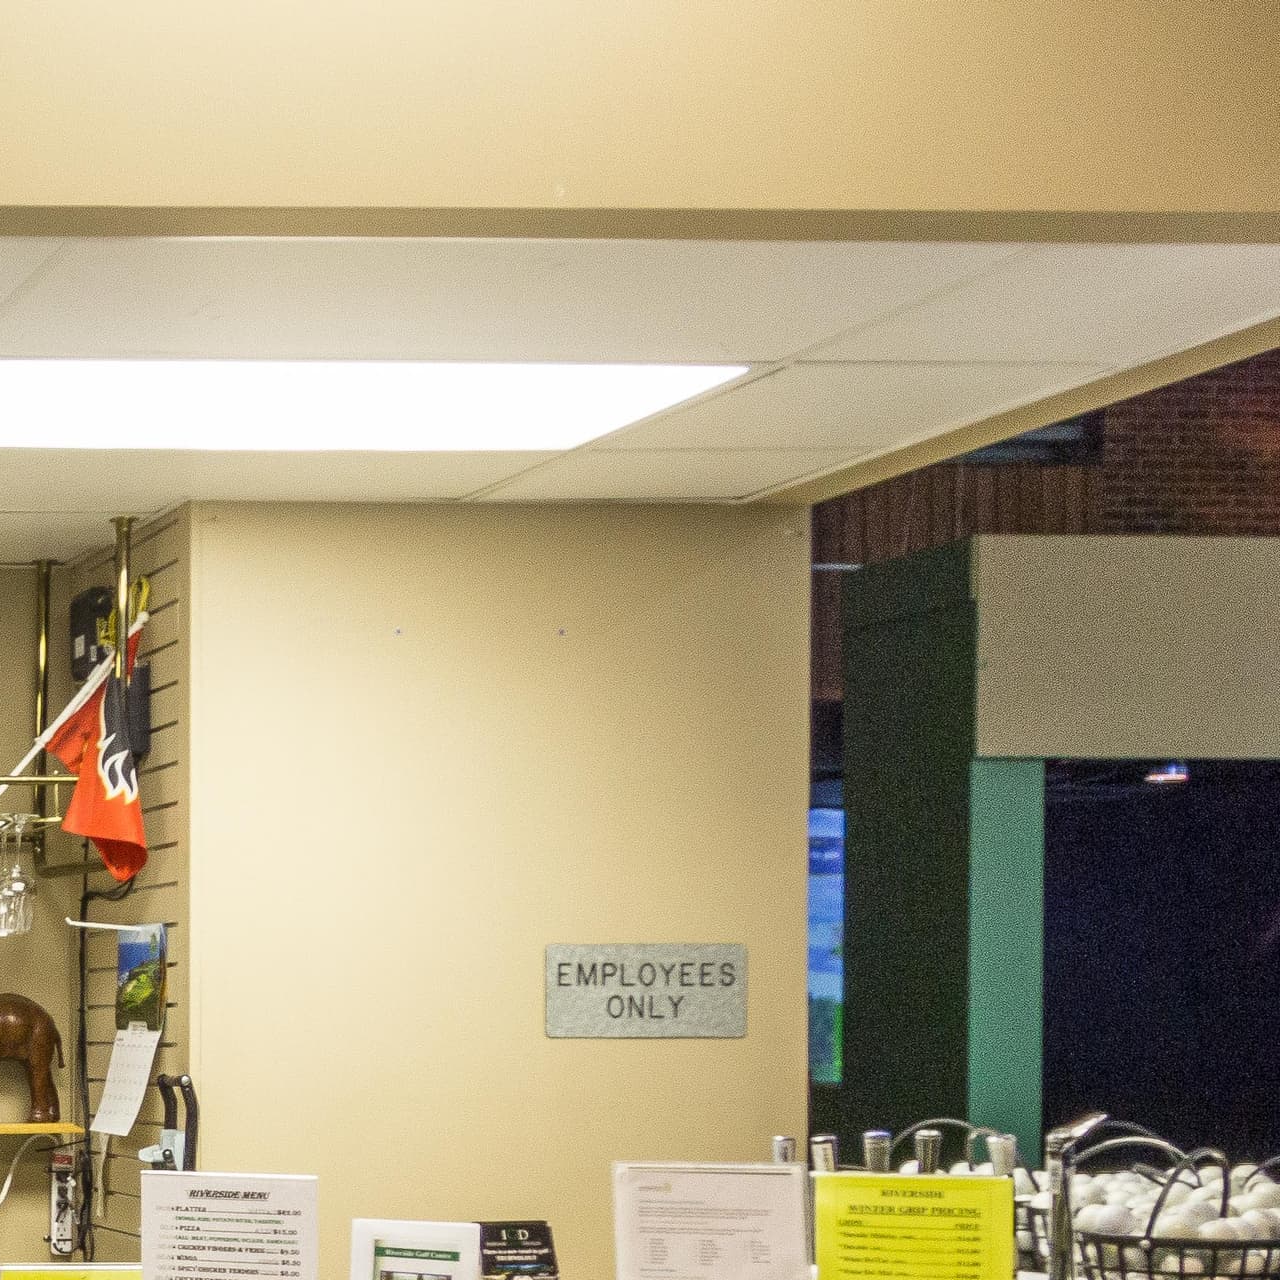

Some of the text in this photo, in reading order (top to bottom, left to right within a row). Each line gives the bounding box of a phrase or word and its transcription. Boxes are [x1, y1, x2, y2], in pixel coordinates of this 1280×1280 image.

[557, 962, 736, 987] EMPLOYEES
[606, 995, 685, 1019] ONLY
[189, 1189, 271, 1200] RIVERSIDE MENU
